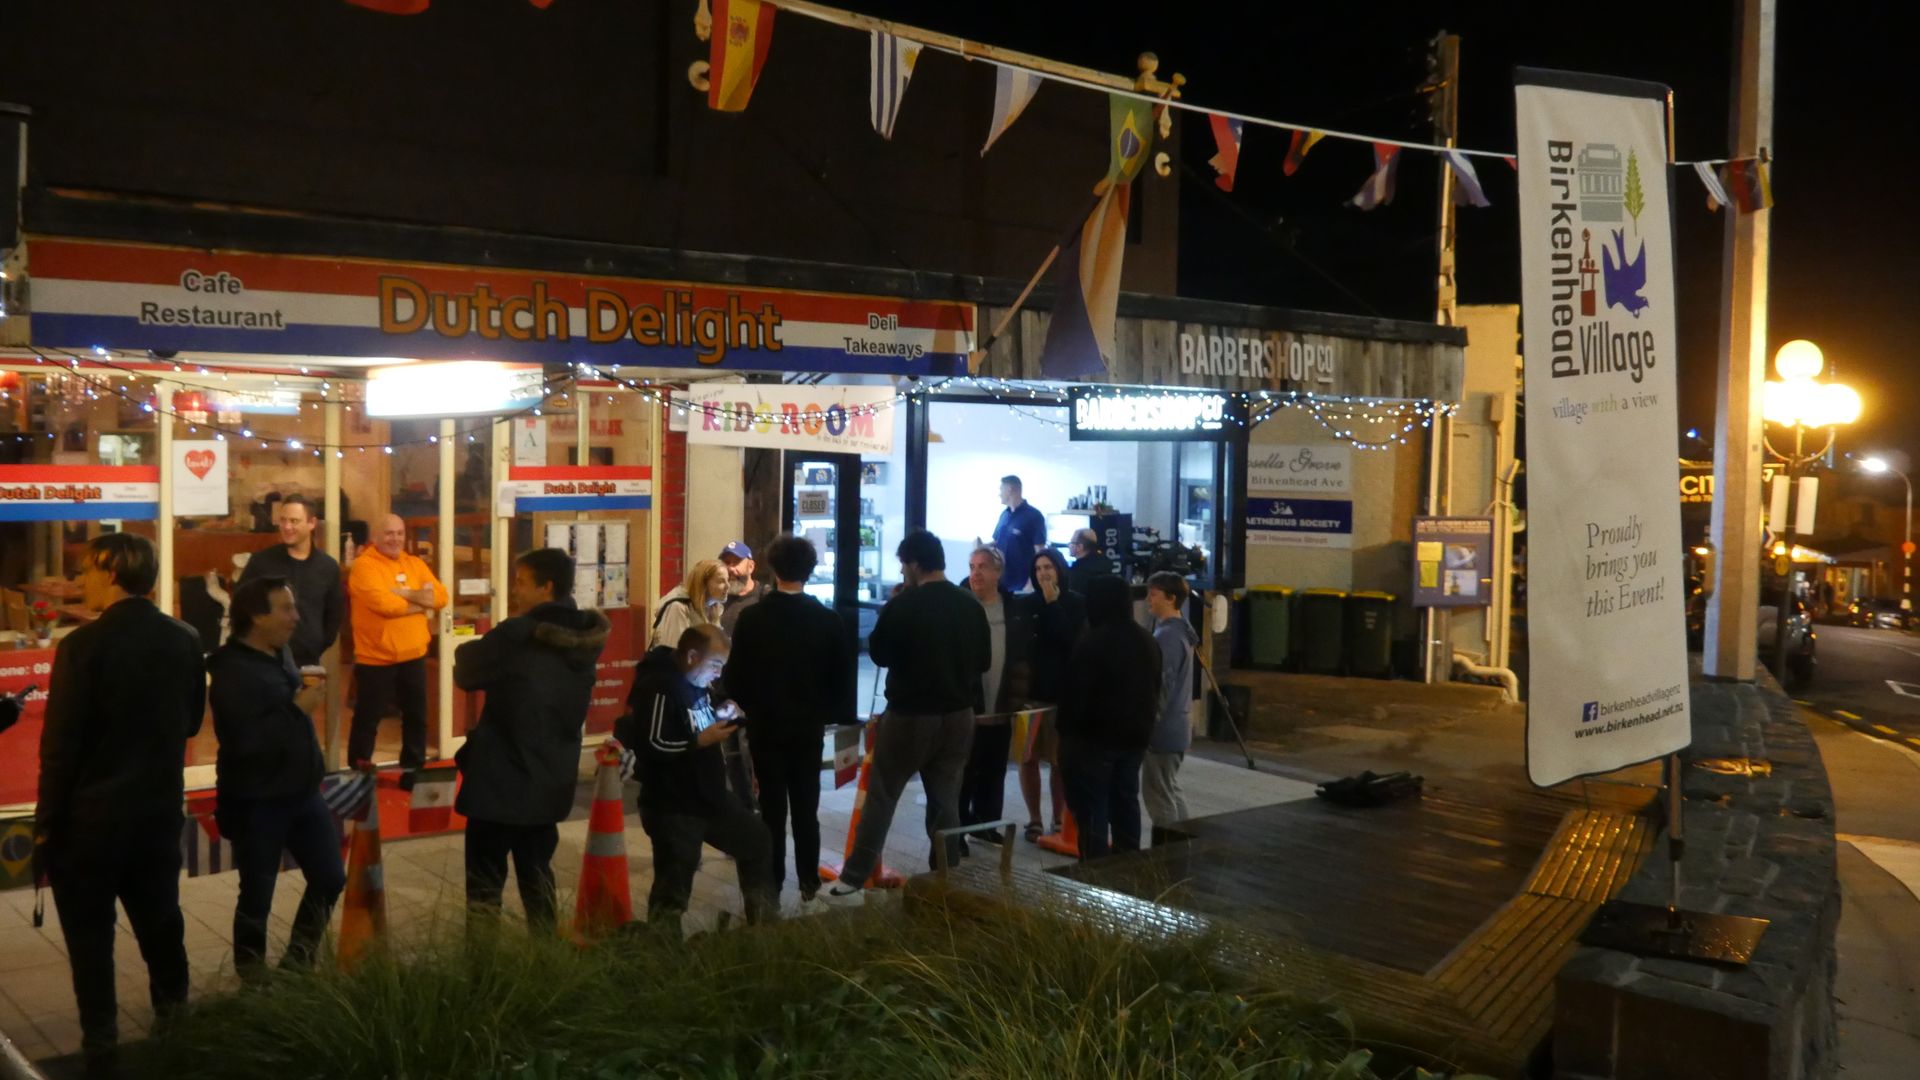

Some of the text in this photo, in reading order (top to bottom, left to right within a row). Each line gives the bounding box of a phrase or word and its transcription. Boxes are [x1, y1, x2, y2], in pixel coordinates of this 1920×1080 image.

[1548, 140, 1580, 378] Birkenhead
[182, 271, 241, 294] Cafe
[141, 302, 283, 328] Restaurant
[380, 276, 783, 365] Dutch Delight
[869, 314, 897, 331] Deli
[843, 337, 923, 359] Takeaways
[1579, 321, 1656, 384] Village
[702, 401, 875, 438] KIDS ROOM
[1552, 391, 1657, 424] village with a view
[44, 484, 102, 504] Delight
[544, 482, 576, 494] Dutch
[578, 481, 617, 497] Delight
[1251, 476, 1344, 488] Birkenhead Ave
[1299, 518, 1342, 529] SOCIETY
[1585, 514, 1642, 549] Proudly
[1586, 550, 1657, 583] brings you
[1586, 576, 1665, 618] this Event!
[1600, 684, 1681, 716] birkenheadvillagenz
[1575, 702, 1684, 738] www.birkenhead.net.nz
